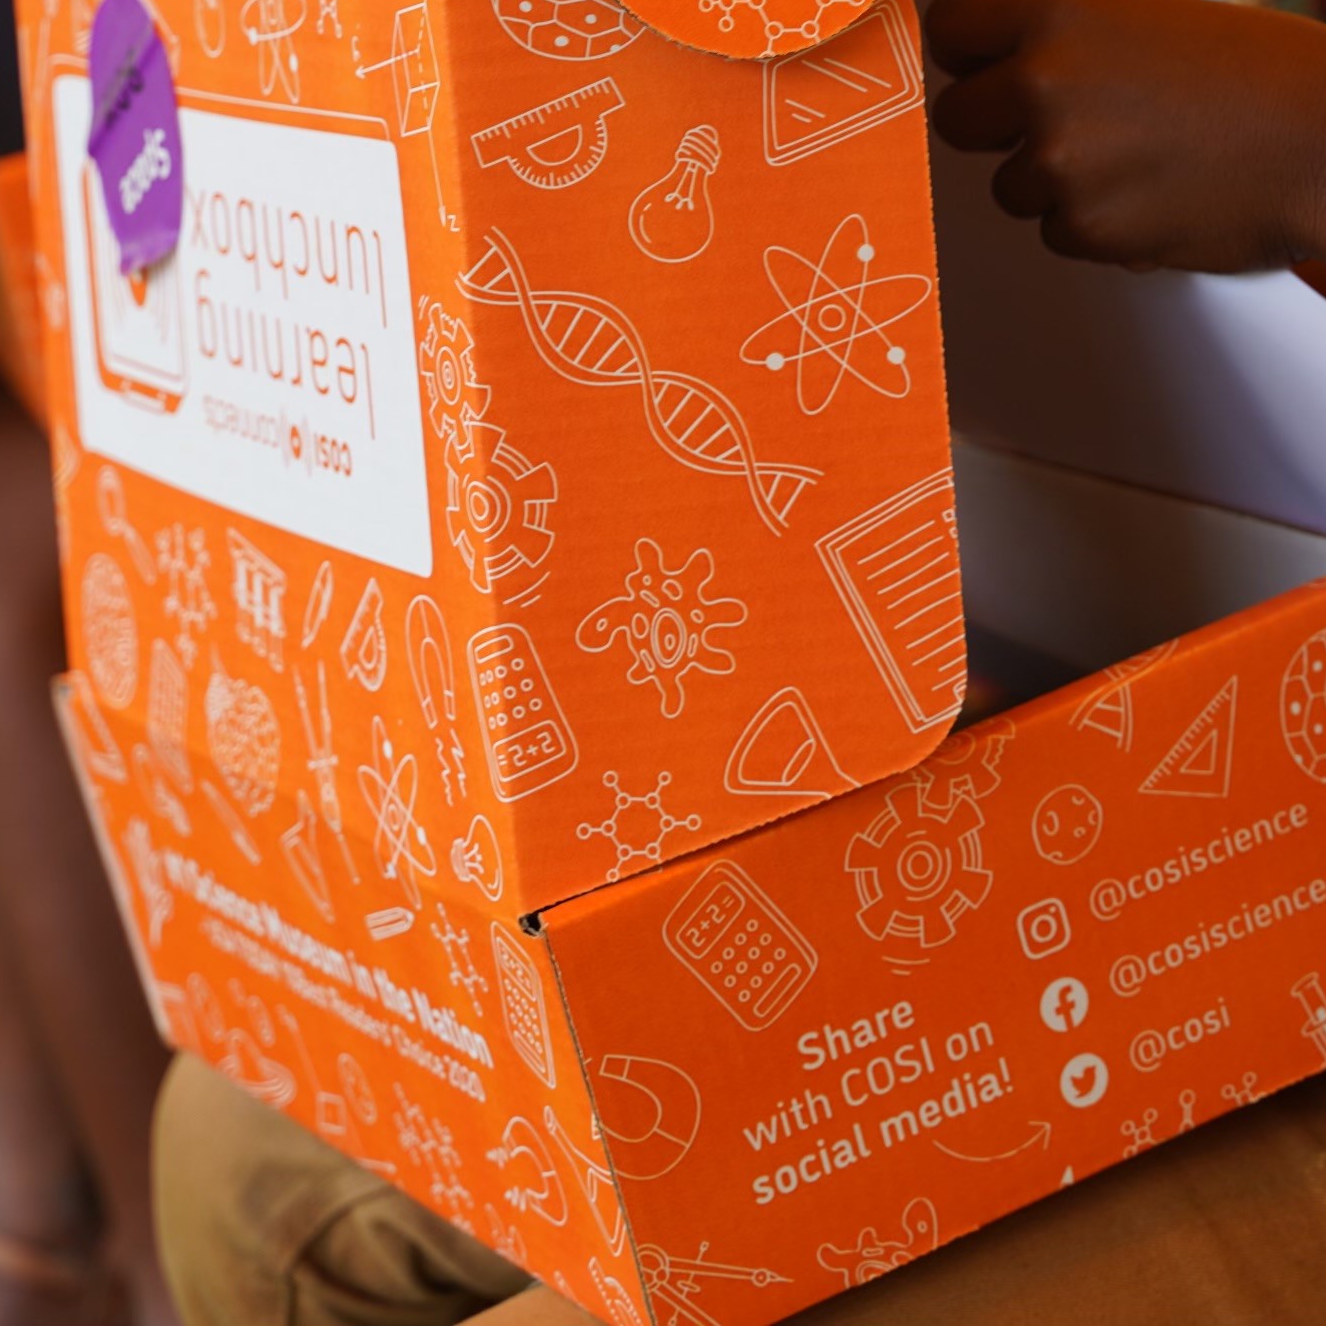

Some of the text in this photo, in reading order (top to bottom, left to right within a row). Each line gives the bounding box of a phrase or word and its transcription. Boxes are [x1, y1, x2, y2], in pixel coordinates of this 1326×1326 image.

[185, 185, 388, 329] lunchbox
[195, 268, 376, 441] learning
[1089, 802, 1309, 922] @cosiscience
[258, 900, 354, 987] Museum
[410, 986, 495, 1070] Nation
[797, 1000, 915, 1071] Share
[1129, 997, 1231, 1073] @cosi
[743, 1021, 994, 1152] with COSI on
[752, 1057, 1014, 1205] social media!
